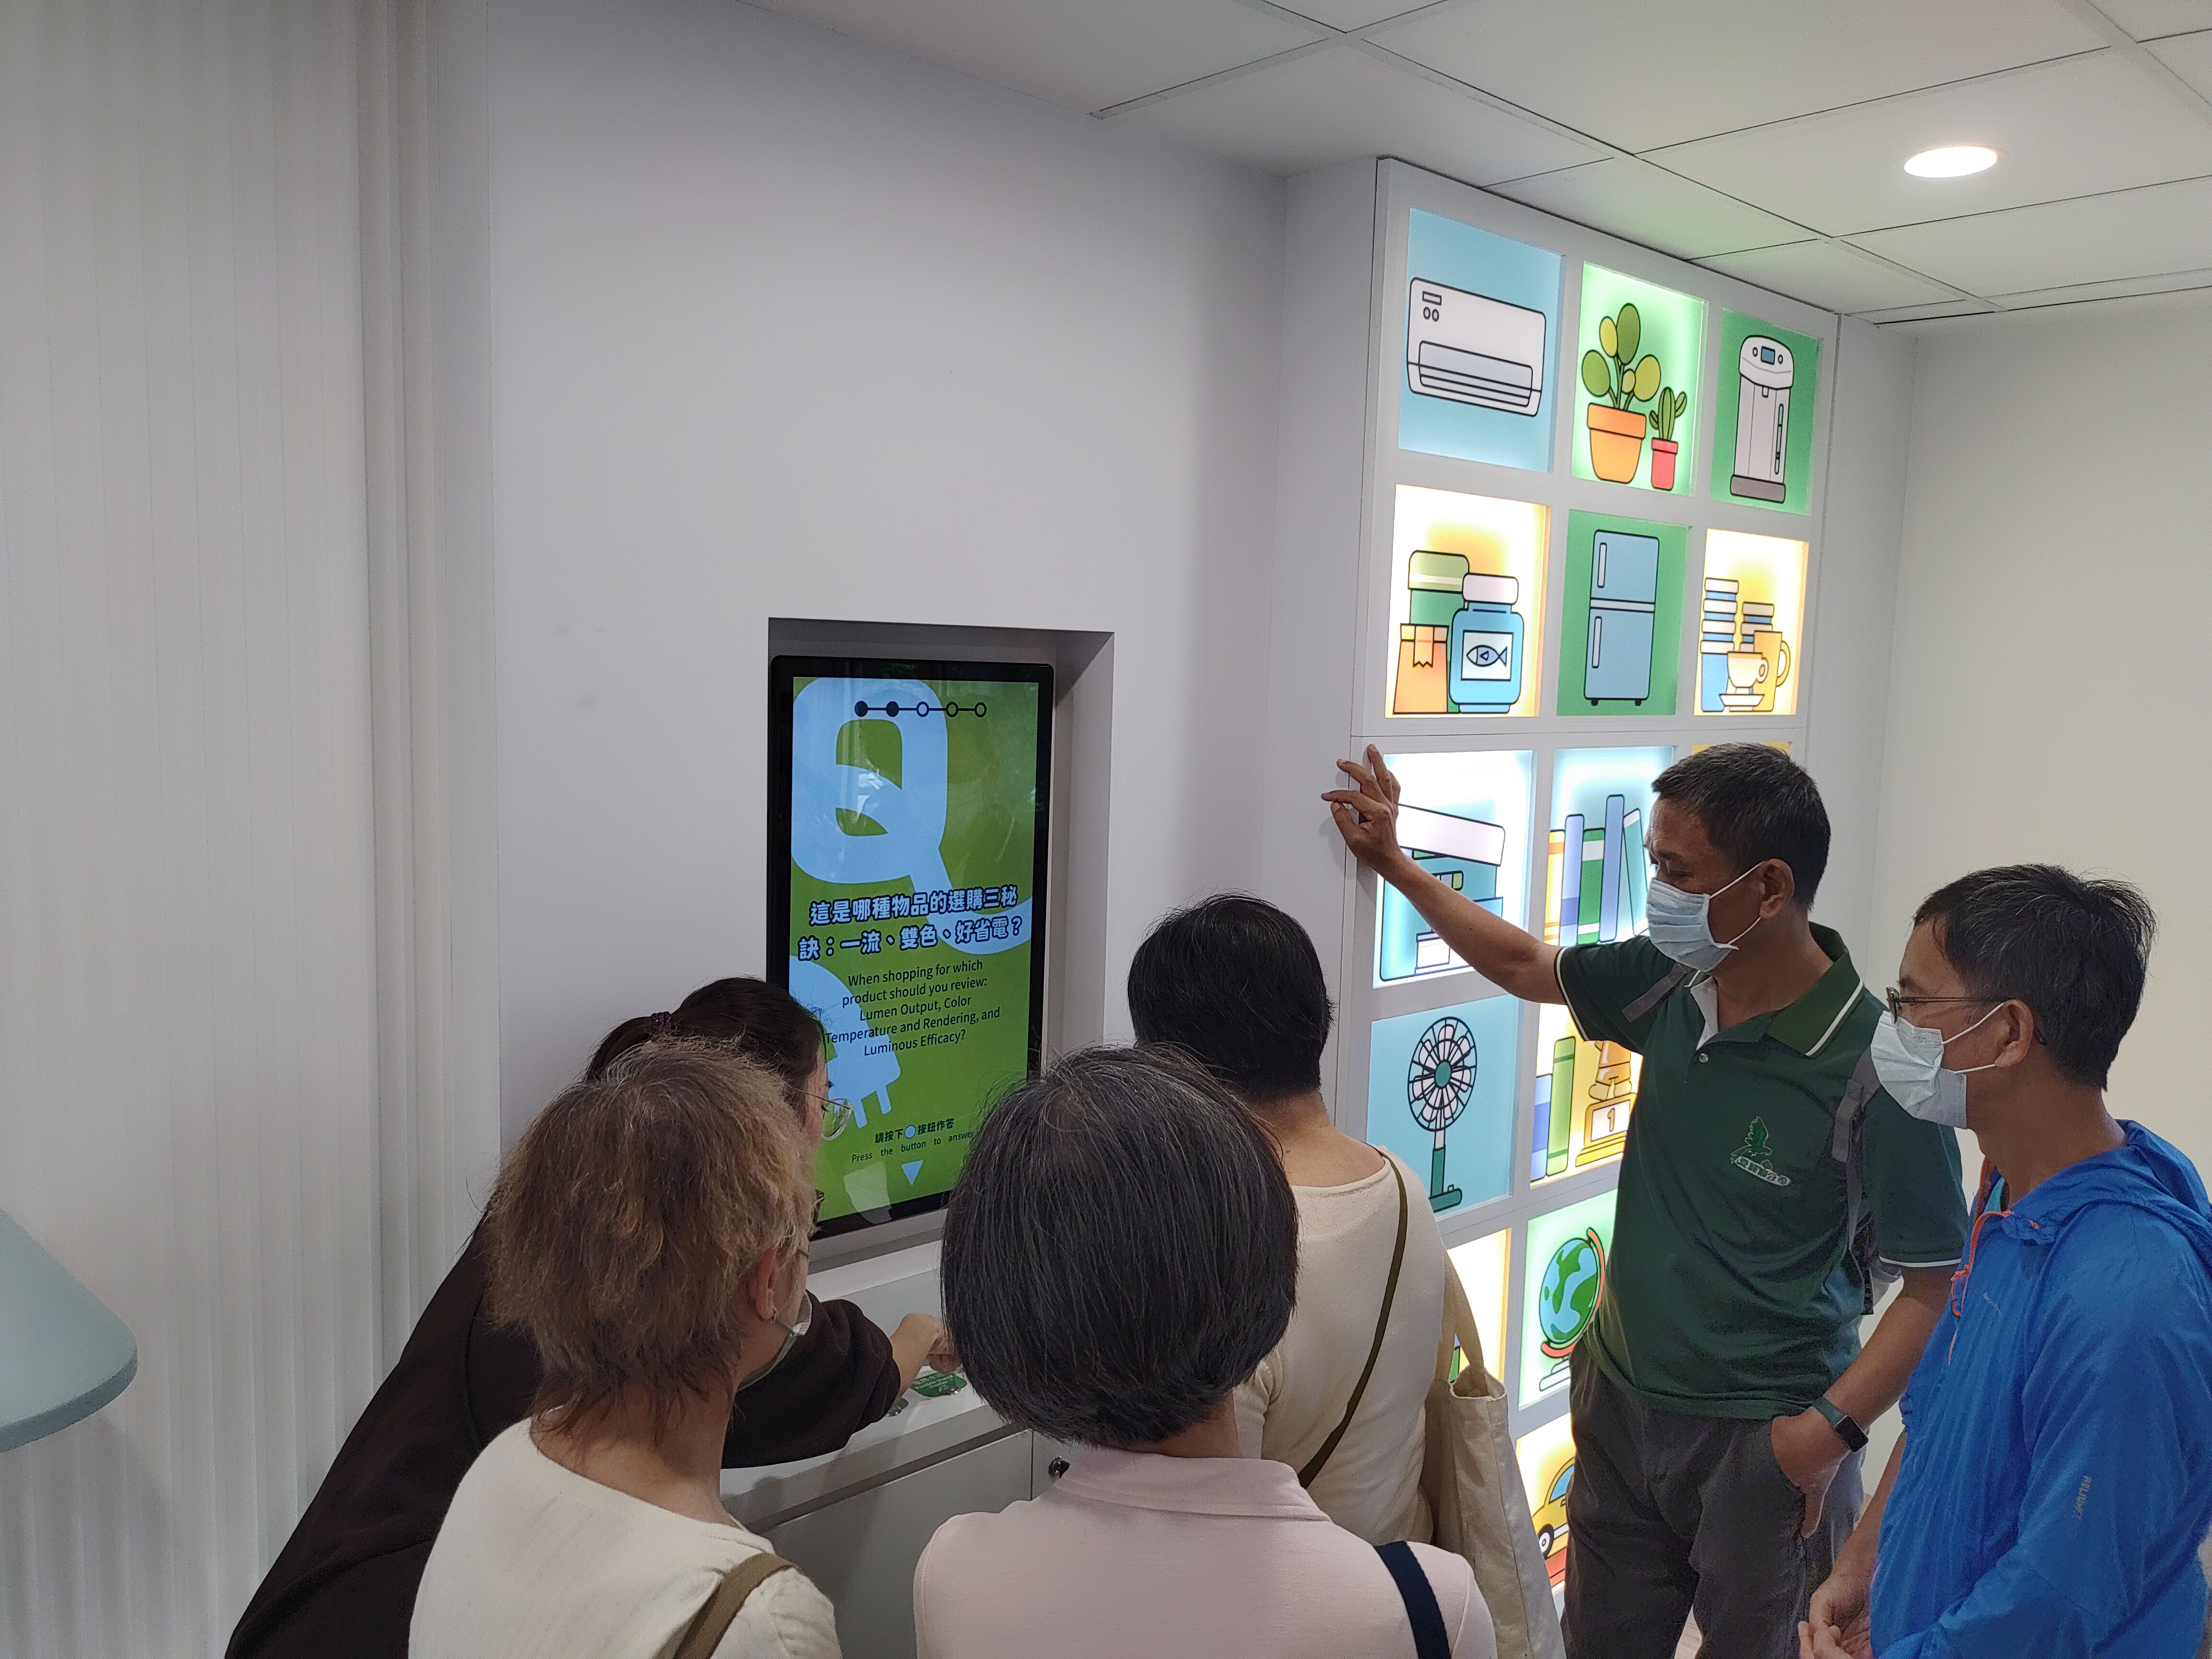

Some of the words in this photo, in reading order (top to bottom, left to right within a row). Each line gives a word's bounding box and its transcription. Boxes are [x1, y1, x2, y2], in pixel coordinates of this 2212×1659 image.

[809, 885, 1018, 926] 這是哪種物品的選購三秘
[848, 973, 880, 986] When
[883, 966, 933, 983] shopping
[936, 963, 950, 975] for
[953, 959, 983, 973] which
[842, 990, 887, 1009] product
[890, 984, 926, 1000] should
[928, 983, 948, 997] you
[951, 977, 987, 991] review:
[860, 1006, 897, 1021] Lumen
[901, 1000, 941, 1015] Output,
[944, 995, 972, 1009] Color
[825, 1024, 897, 1044] Temperature
[900, 1019, 920, 1033] and
[923, 1012, 979, 1028] Rendering,
[982, 1007, 1000, 1020] and
[864, 1038, 918, 1056] Luminous
[921, 1029, 966, 1047] Efficacy?
[875, 1129, 903, 1143] 請按下
[917, 1118, 954, 1135] 按鈕作答
[1607, 1107, 1615, 1132] 1
[852, 1153, 872, 1163] Press
[881, 1147, 893, 1156] the
[901, 1141, 926, 1152] button
